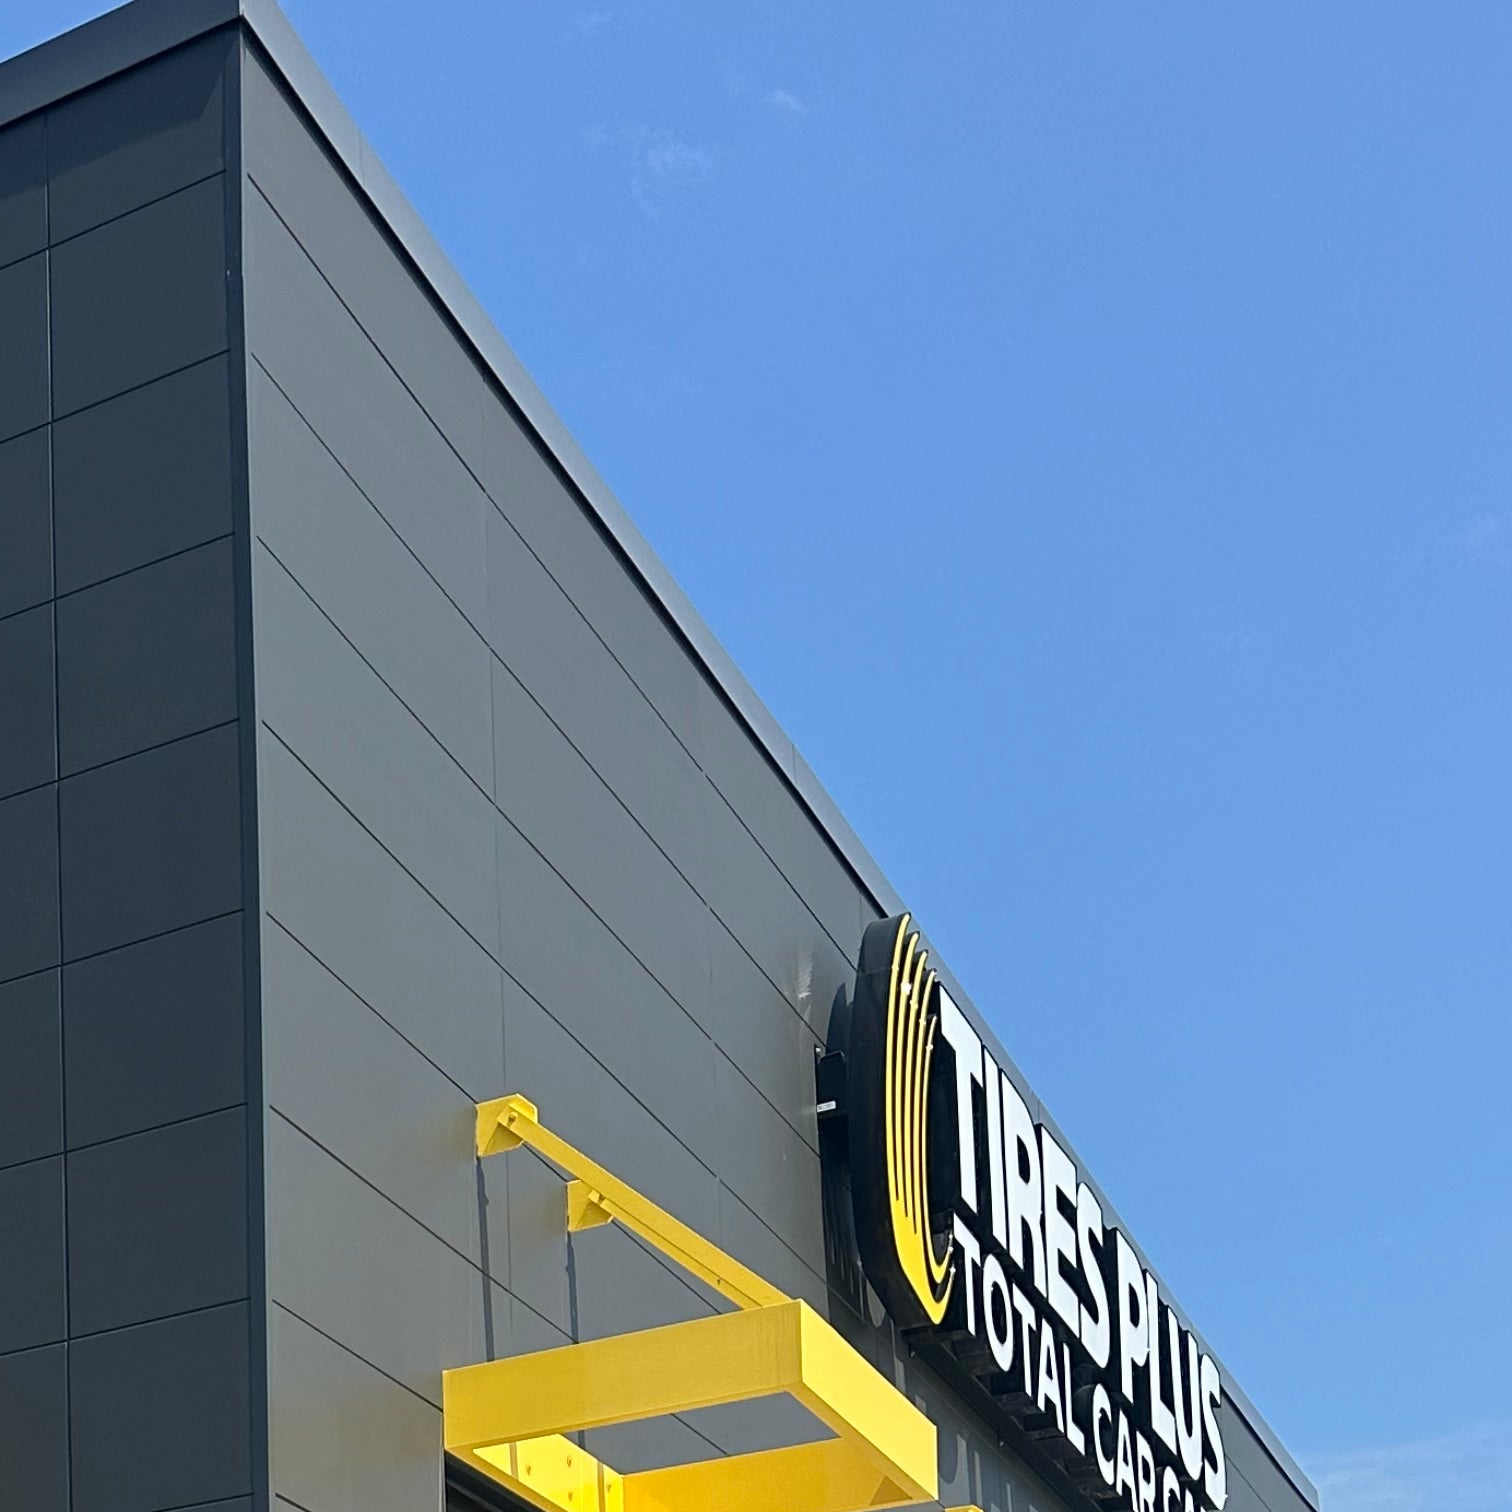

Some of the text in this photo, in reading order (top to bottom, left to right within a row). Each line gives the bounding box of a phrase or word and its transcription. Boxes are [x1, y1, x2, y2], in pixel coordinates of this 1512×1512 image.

[939, 982, 1228, 1511] TIRES PLUS
[953, 1222, 1085, 1456] TOTAL
